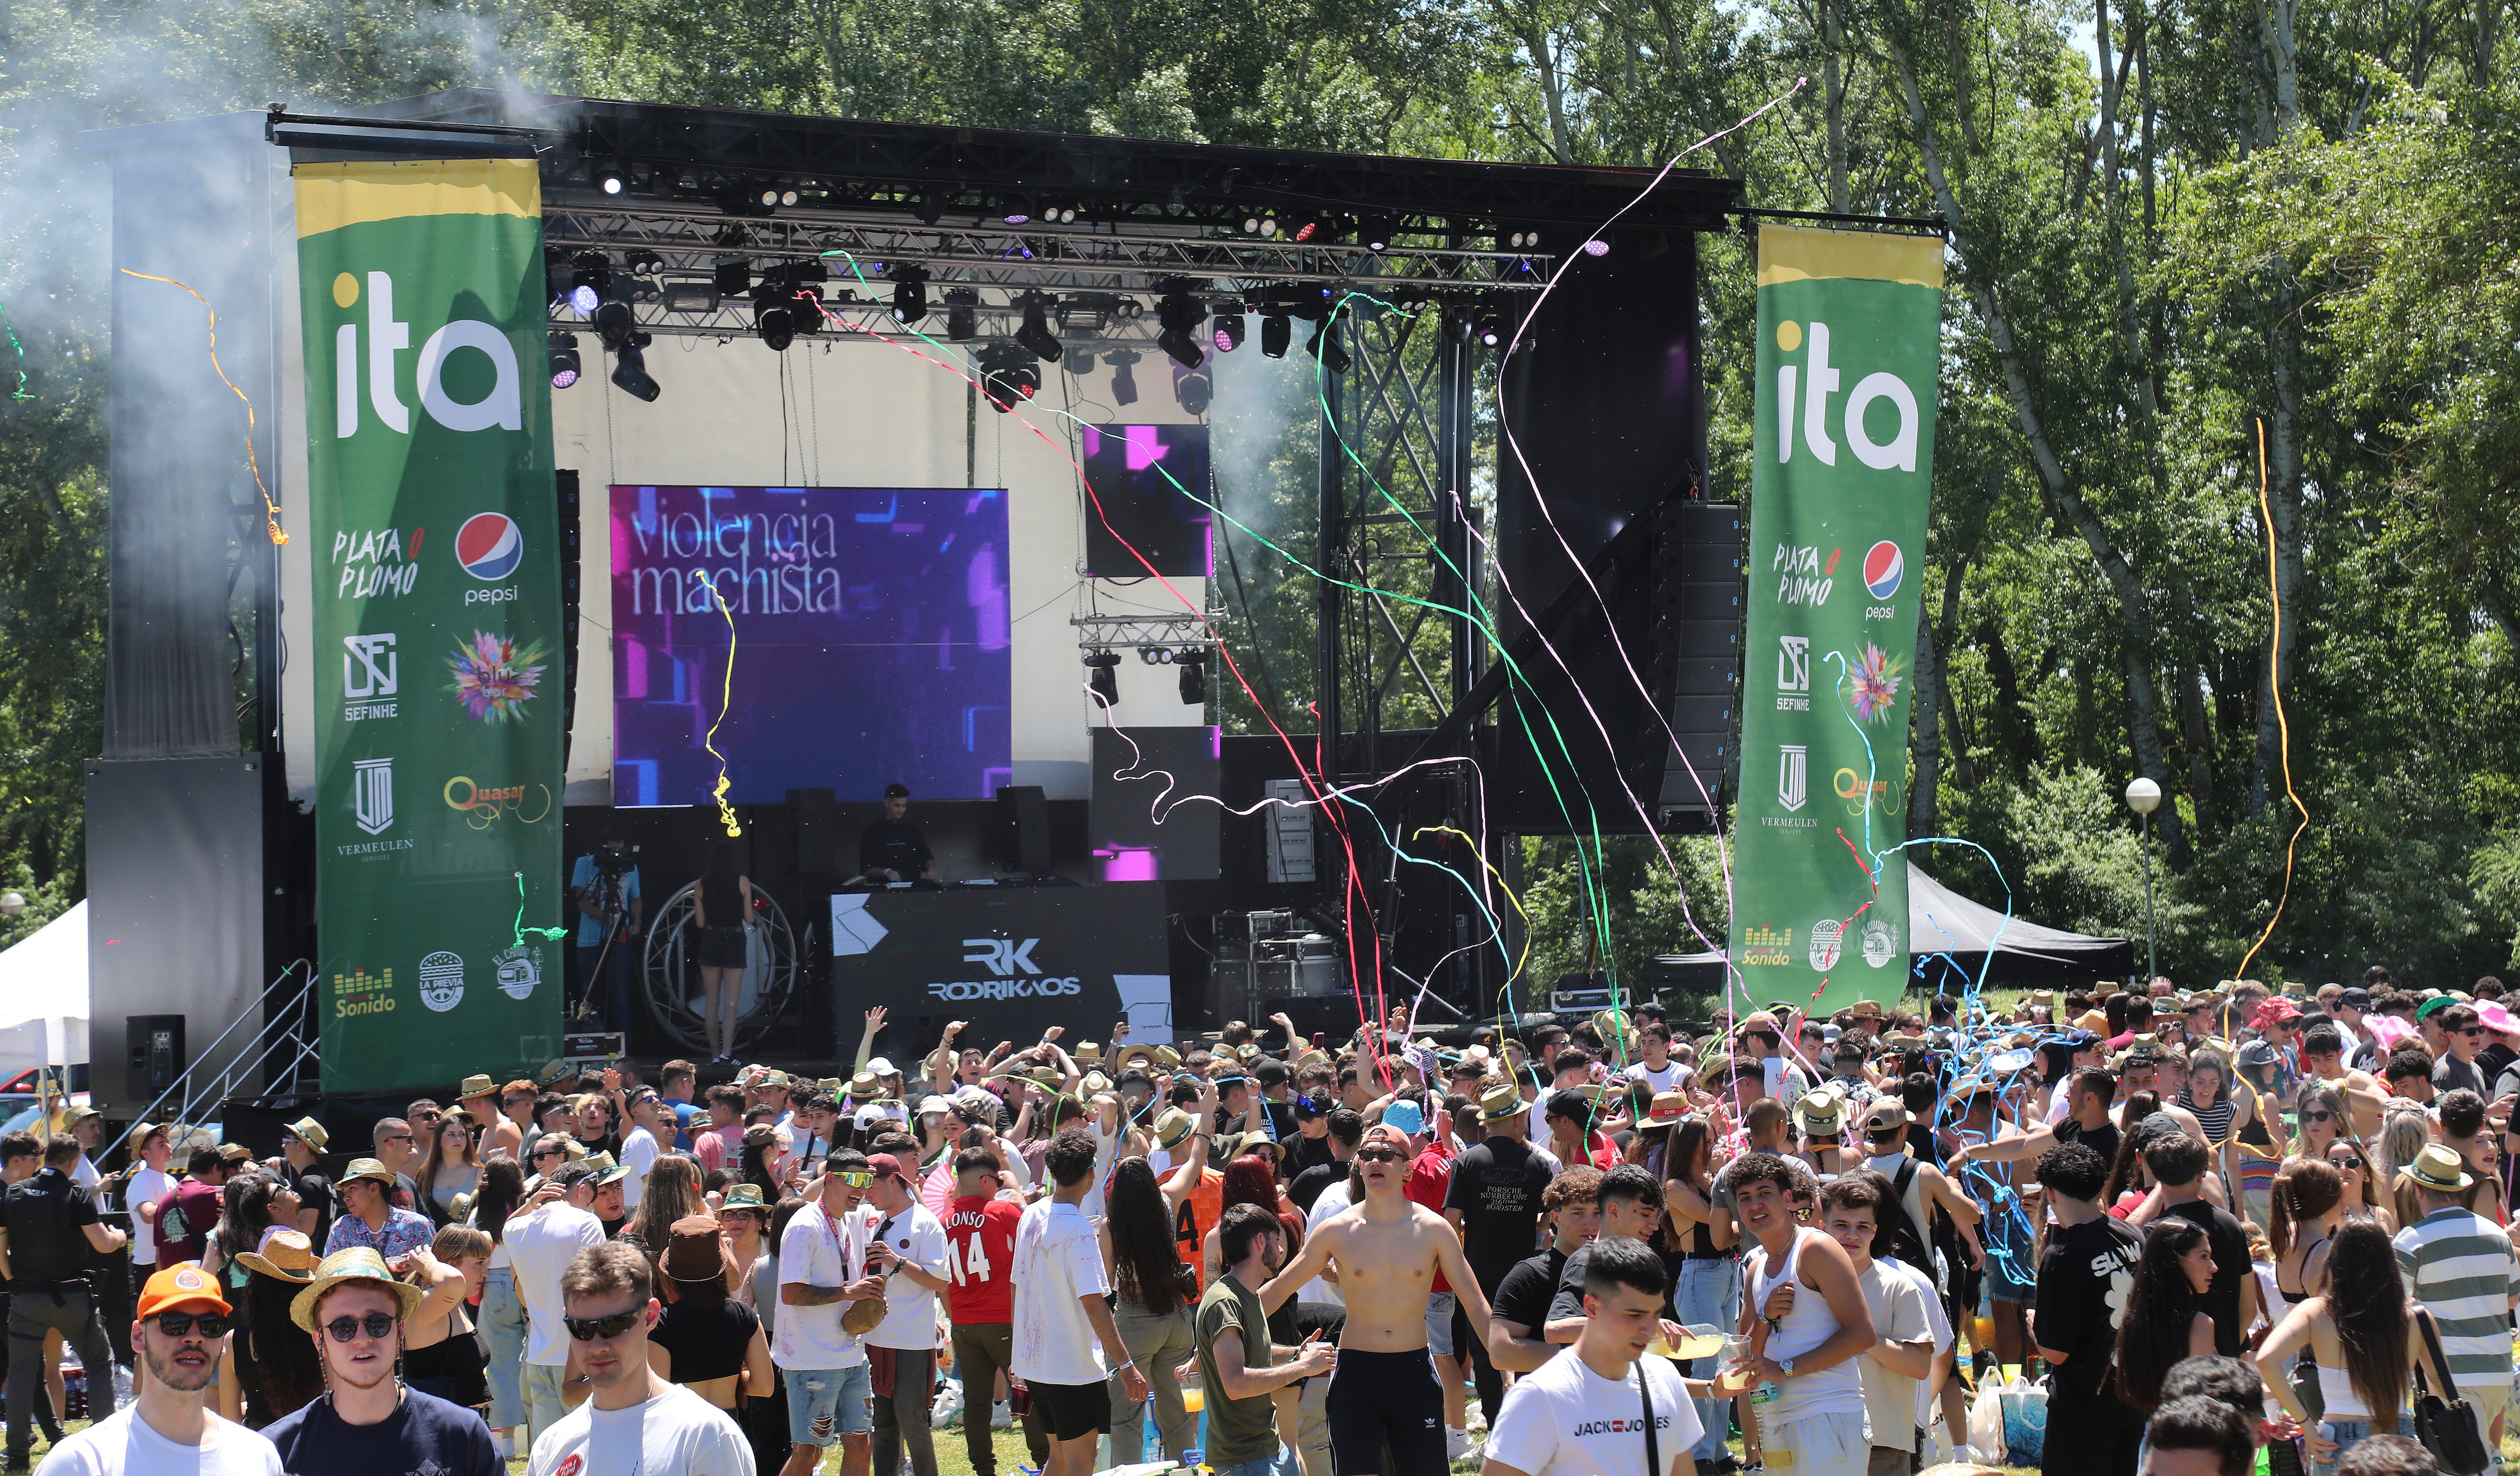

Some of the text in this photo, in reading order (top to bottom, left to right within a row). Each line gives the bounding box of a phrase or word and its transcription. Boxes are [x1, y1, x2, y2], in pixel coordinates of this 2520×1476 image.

[333, 271, 522, 439] ita
[1776, 320, 1919, 472] ita
[632, 498, 837, 559] violencia
[333, 528, 401, 565] PLATA
[1773, 542, 1819, 577] PLATA
[338, 562, 418, 599] PLOMO
[633, 541, 841, 615] machista
[465, 585, 518, 606] pepsi
[1777, 574, 1833, 608] PLOMO
[1865, 605, 1895, 622] pepsi
[482, 686, 507, 697] bar
[345, 704, 398, 721] SEFINHE
[1777, 697, 1810, 711] SEFINHE
[444, 776, 525, 820] Quasar
[1761, 817, 1817, 828] VERMEULEN
[337, 839, 414, 855] VERMEULEN
[361, 854, 391, 863] SERVICES
[1861, 919, 1888, 937] EL CAMINO
[492, 946, 530, 966] EL CAMINO
[963, 938, 1043, 976] RK
[1741, 949, 1790, 966] Sonido
[419, 978, 464, 989] LA PREVIA
[336, 993, 396, 1018] Sonido
[1487, 1186, 1522, 1194] PORSCHE
[946, 1210, 985, 1230] LONSO
[949, 1231, 991, 1287] 14
[1574, 1415, 1670, 1437] JACK JOES
